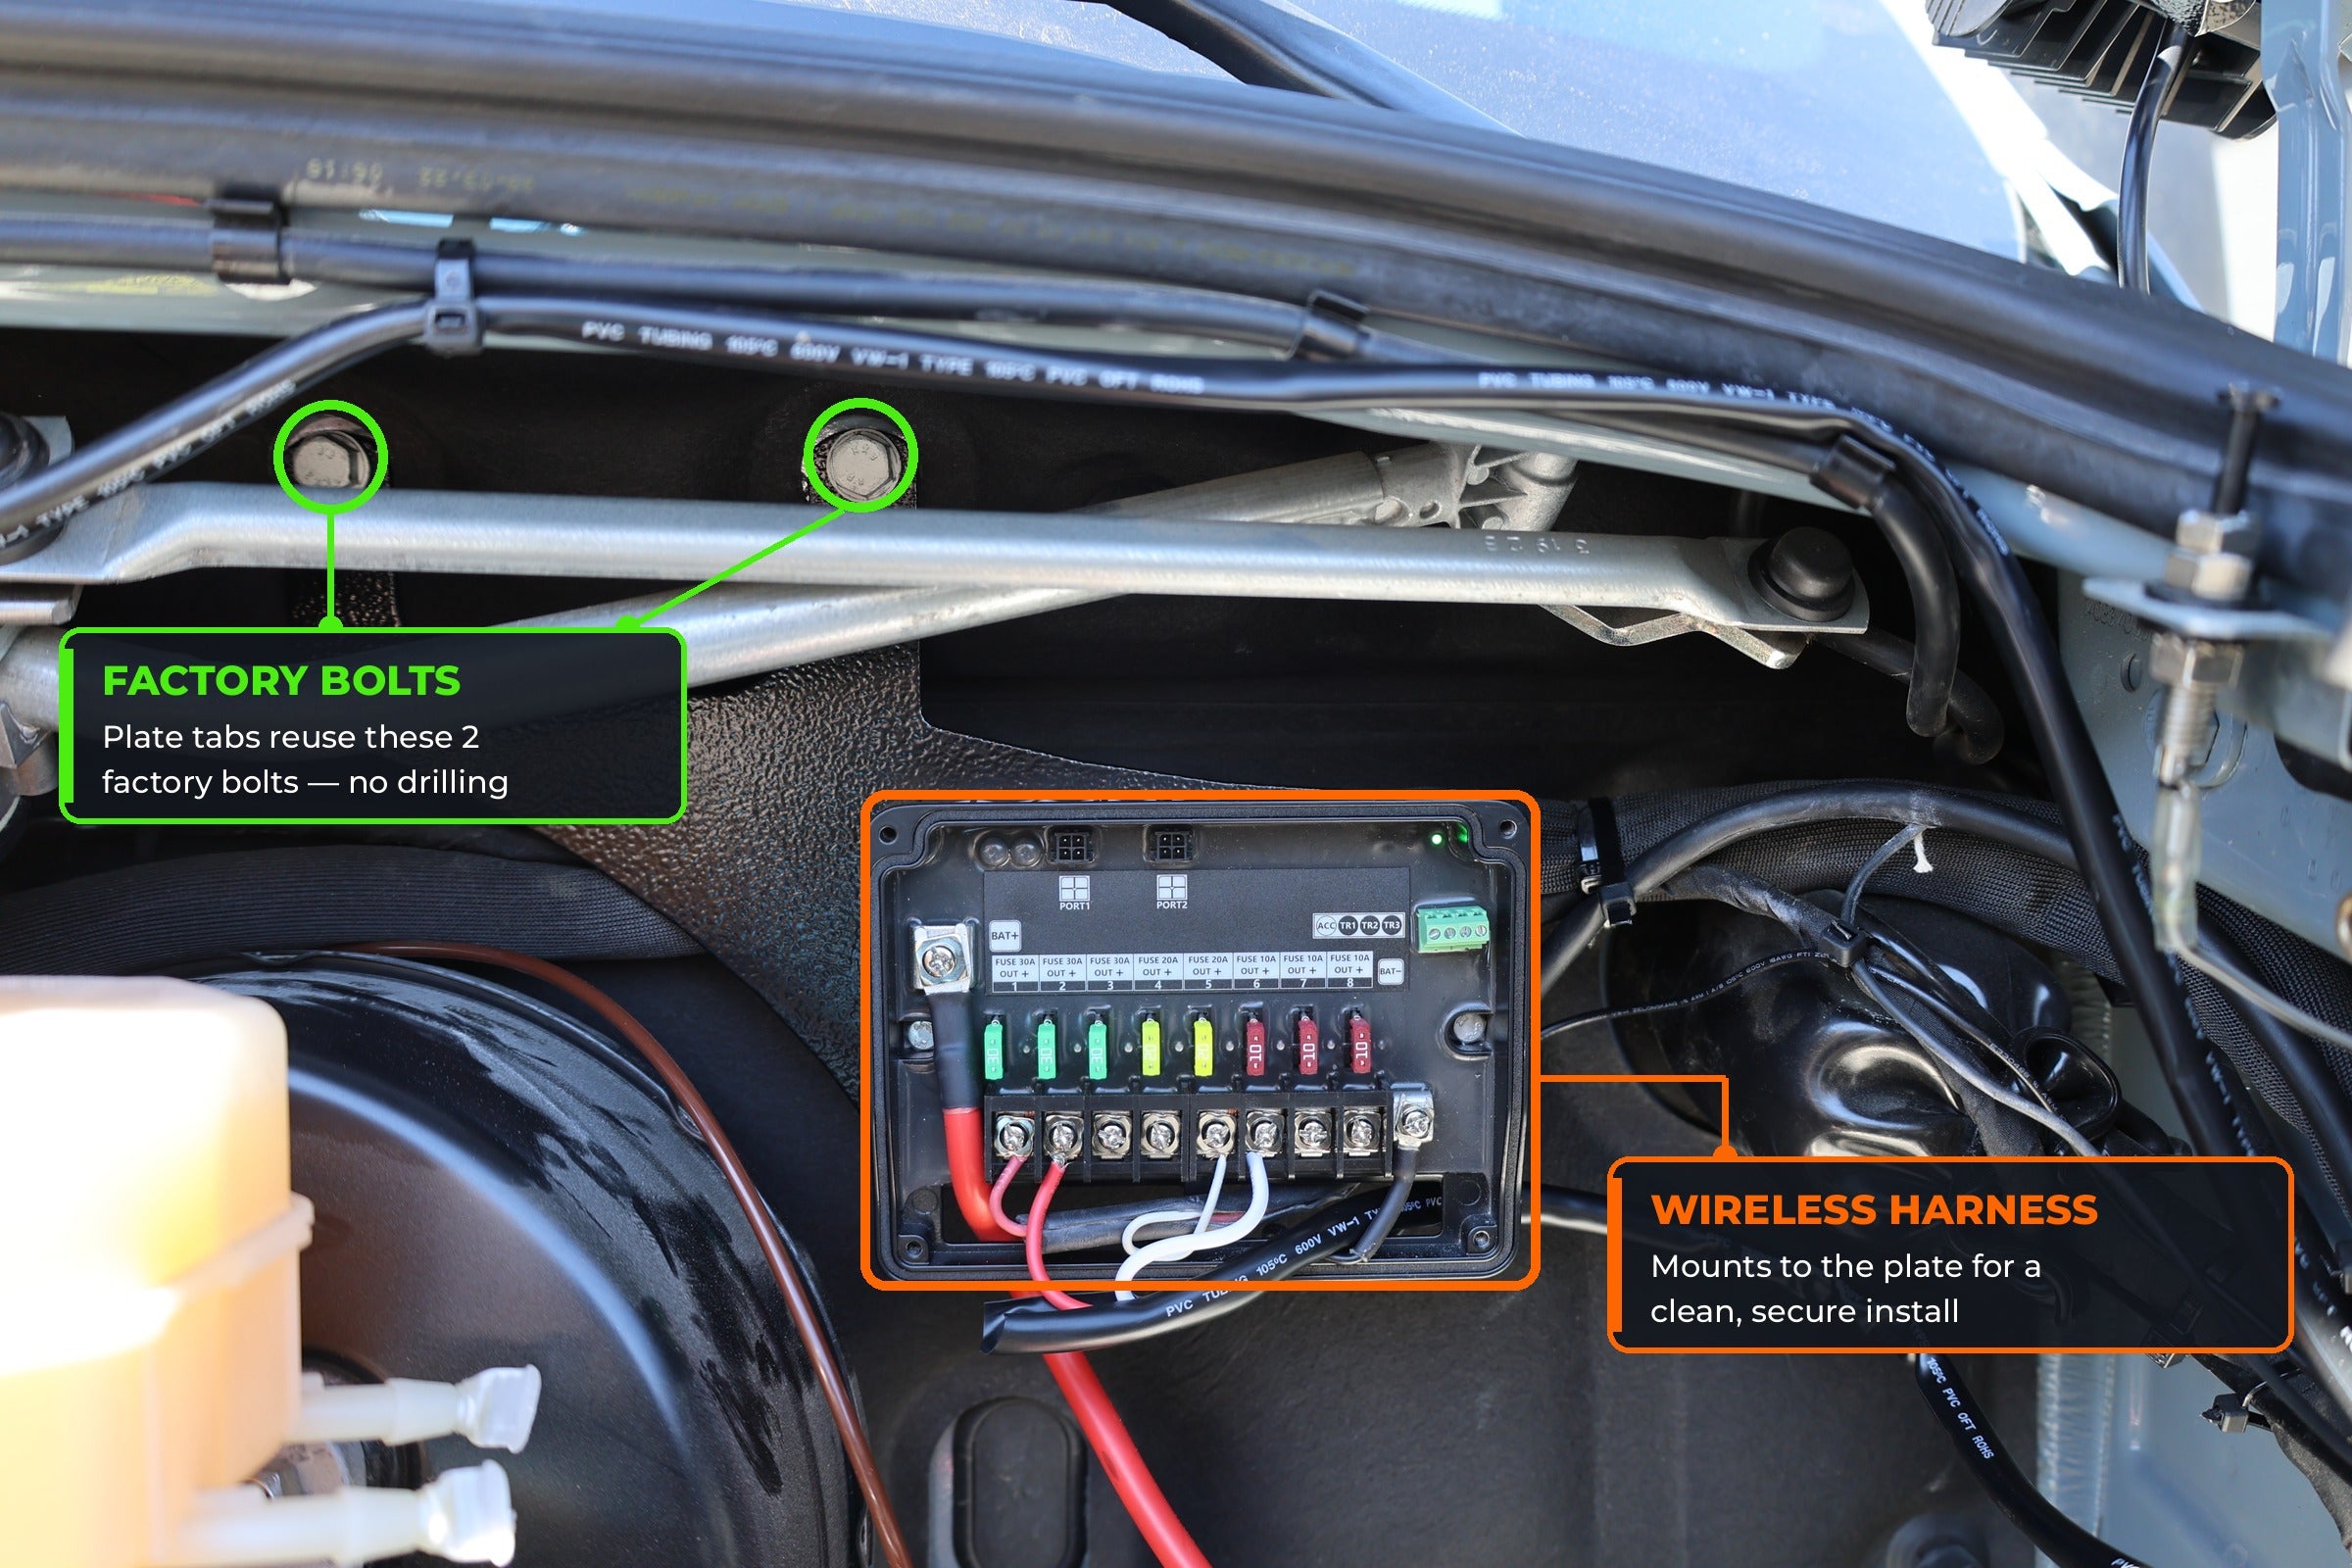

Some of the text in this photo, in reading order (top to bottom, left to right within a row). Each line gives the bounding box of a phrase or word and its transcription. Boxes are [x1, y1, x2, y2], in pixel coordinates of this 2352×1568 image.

[582, 320, 625, 341] PVC
[919, 353, 973, 377] TYPE
[1045, 366, 1088, 387] PVC
[1059, 902, 1090, 910] PORT1
[1156, 901, 1188, 909] PORT2
[1317, 921, 1336, 930] ACC
[1383, 920, 1400, 929] TR3
[991, 931, 1019, 941] BAT+
[995, 957, 1017, 966] FUSE
[1066, 956, 1083, 965] 30A
[1090, 956, 1111, 965] FUSE
[1161, 956, 1178, 964] 20A
[1189, 956, 1210, 964] FUSE
[1284, 955, 1304, 963] FUSE
[1047, 969, 1065, 978] OUT
[1143, 968, 1161, 977] OUT
[1288, 966, 1306, 975] OUT
[1011, 982, 1017, 991] 1
[1059, 981, 1066, 991] 2
[1107, 981, 1114, 990] 3
[1154, 981, 1162, 990] 4
[1205, 980, 1212, 989] 5
[1253, 979, 1260, 989] 6
[1300, 979, 1307, 988] 7
[1347, 978, 1354, 988] 8
[1250, 1045, 1262, 1061] 10
[1302, 1043, 1315, 1060] 10
[1355, 1042, 1368, 1058] 10
[1165, 1299, 1194, 1317] PVC
[1295, 1233, 1322, 1255] 600V
[1328, 1216, 1360, 1237] VW-1
[1425, 1197, 1443, 1207] PVC
[1942, 1387, 1961, 1408] PVC
[1957, 1412, 1977, 1431] OFT
[1972, 1435, 1995, 1459] ROHS
